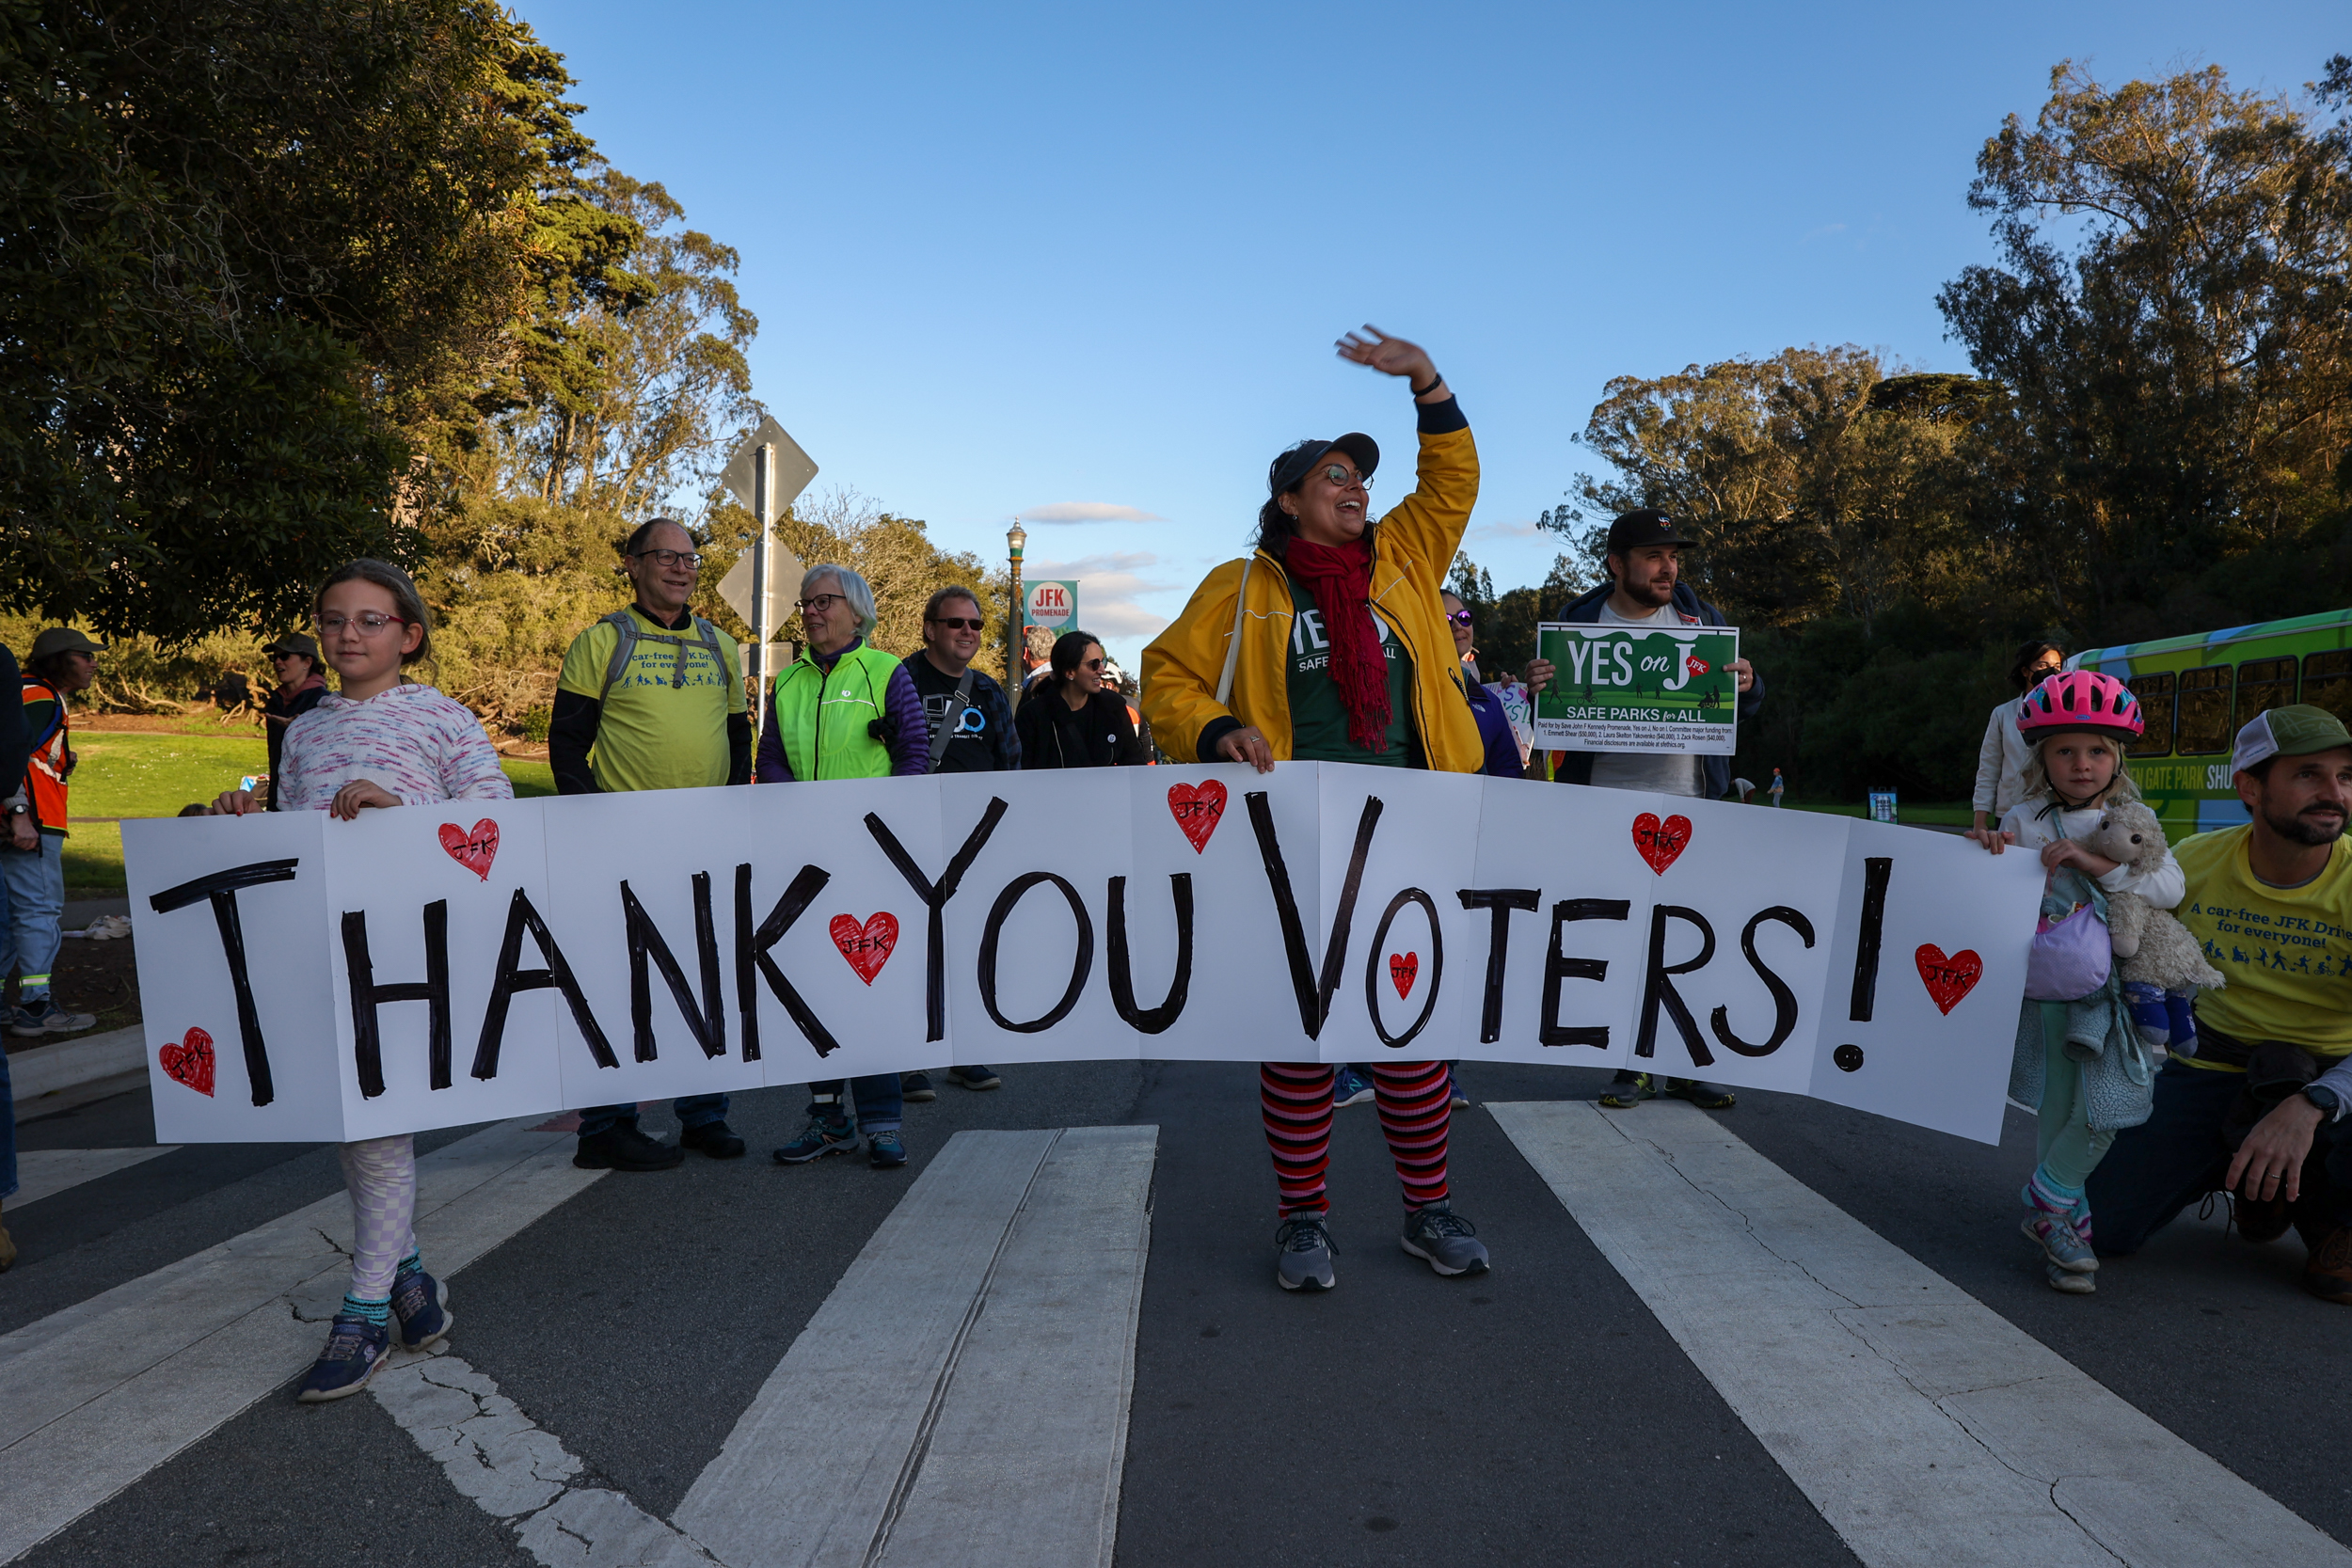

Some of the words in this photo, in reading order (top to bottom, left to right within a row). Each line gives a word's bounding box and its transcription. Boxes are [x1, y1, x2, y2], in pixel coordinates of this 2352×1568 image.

[1036, 589, 1064, 607] JFK
[1031, 609, 1070, 617] PROMENADE
[1293, 609, 1329, 655] YE
[660, 661, 708, 670] eveyone!
[1298, 656, 1329, 673] SAFE
[1567, 641, 1633, 687] YES
[1641, 656, 1670, 673] on
[1662, 643, 1696, 691] J
[1687, 658, 1707, 673] JFK
[1566, 706, 1606, 720] SAFE
[1610, 707, 1661, 721] PARKS
[1662, 710, 1677, 723] for
[1677, 709, 1706, 722] ALL
[2145, 767, 2172, 789] GATE
[2174, 765, 2205, 789] PARK
[2206, 764, 2237, 789] SHU
[1176, 798, 1221, 818] JFK
[453, 837, 497, 860] JFK
[1638, 830, 1681, 852] JFK
[2190, 902, 2201, 914] A
[2206, 905, 2270, 925] car-free
[2274, 915, 2311, 931] JFK
[842, 934, 888, 954] JFK
[2217, 919, 2240, 933] for
[2244, 926, 2327, 949] everyone!
[150, 858, 840, 1107] THANK
[864, 797, 1193, 1042] YOU
[1244, 792, 1893, 1072] VOTERS!
[1391, 966, 1416, 978] JFK
[1926, 965, 1973, 990] JFK
[171, 1041, 213, 1079] JFK
